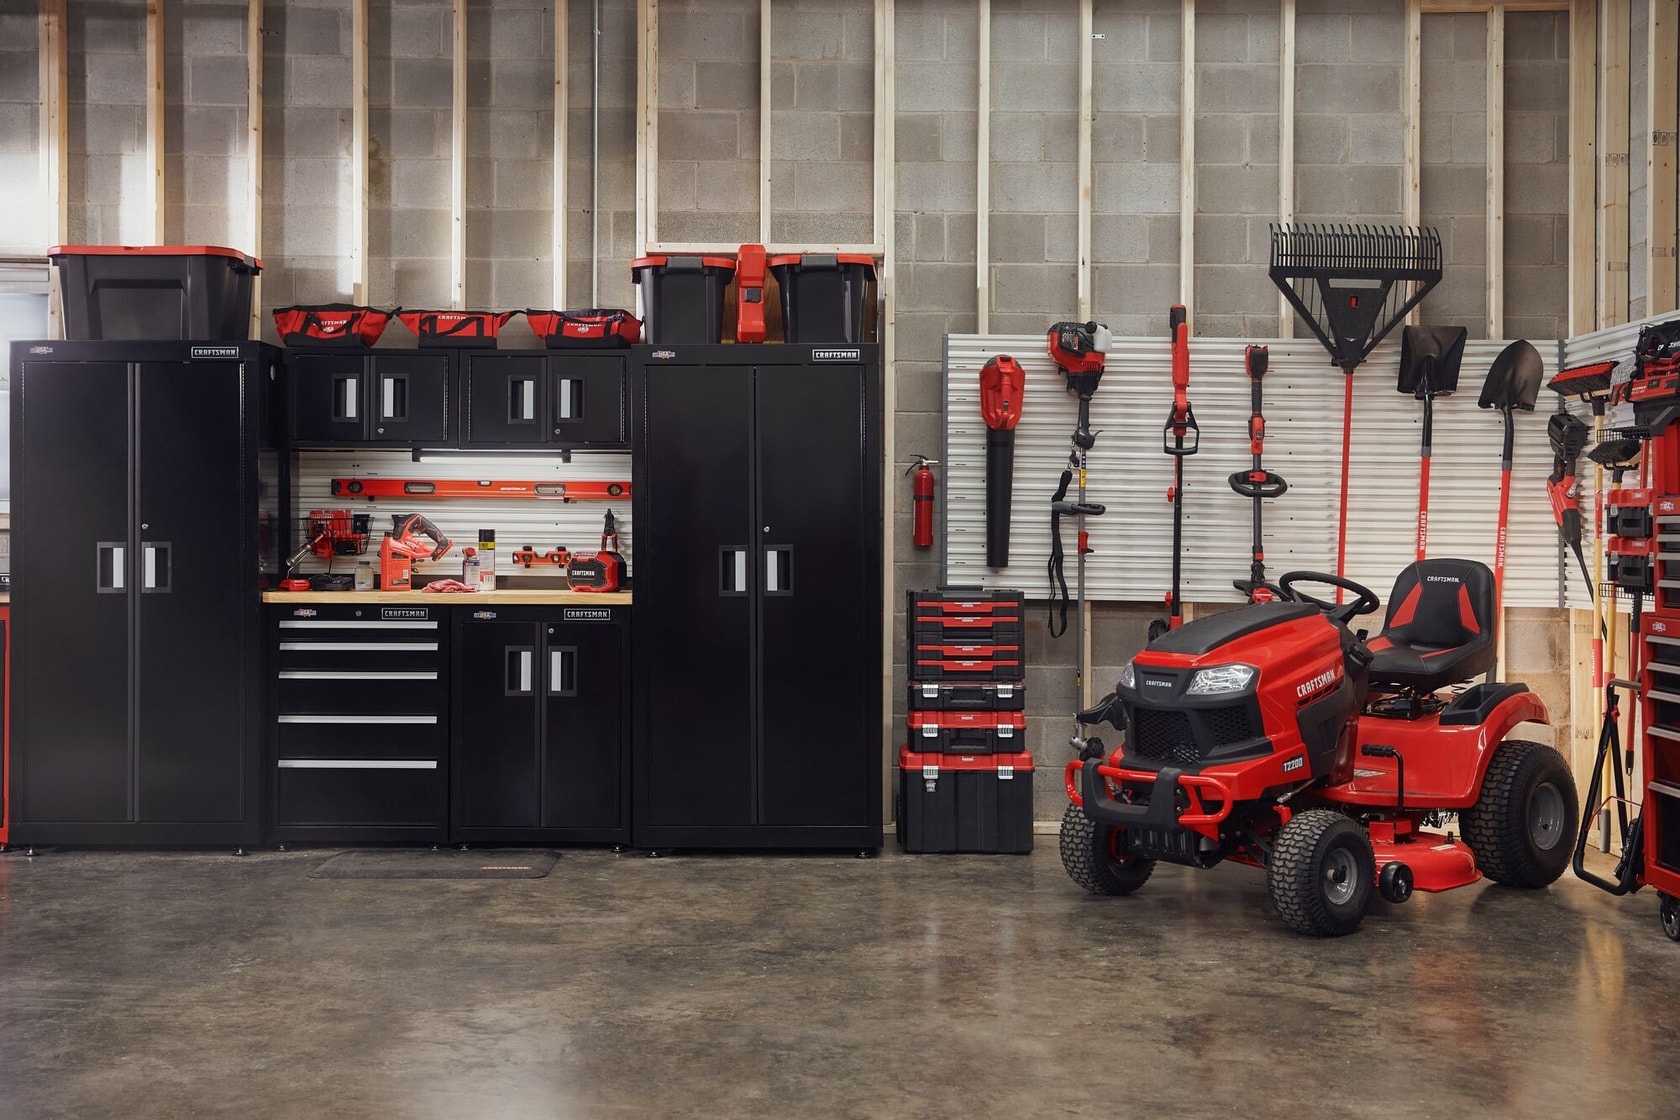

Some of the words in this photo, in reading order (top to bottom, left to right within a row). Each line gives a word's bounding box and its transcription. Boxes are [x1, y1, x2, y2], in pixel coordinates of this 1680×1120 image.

[815, 351, 857, 359] CRAFTSMAN
[1498, 526, 1506, 568] CRAFTSMAN
[1426, 575, 1460, 583] CRAFTSMAN
[1145, 680, 1172, 688] CRAFTSMAN
[1297, 669, 1336, 698] CRAFTSMAN
[1283, 757, 1303, 773] T2200
